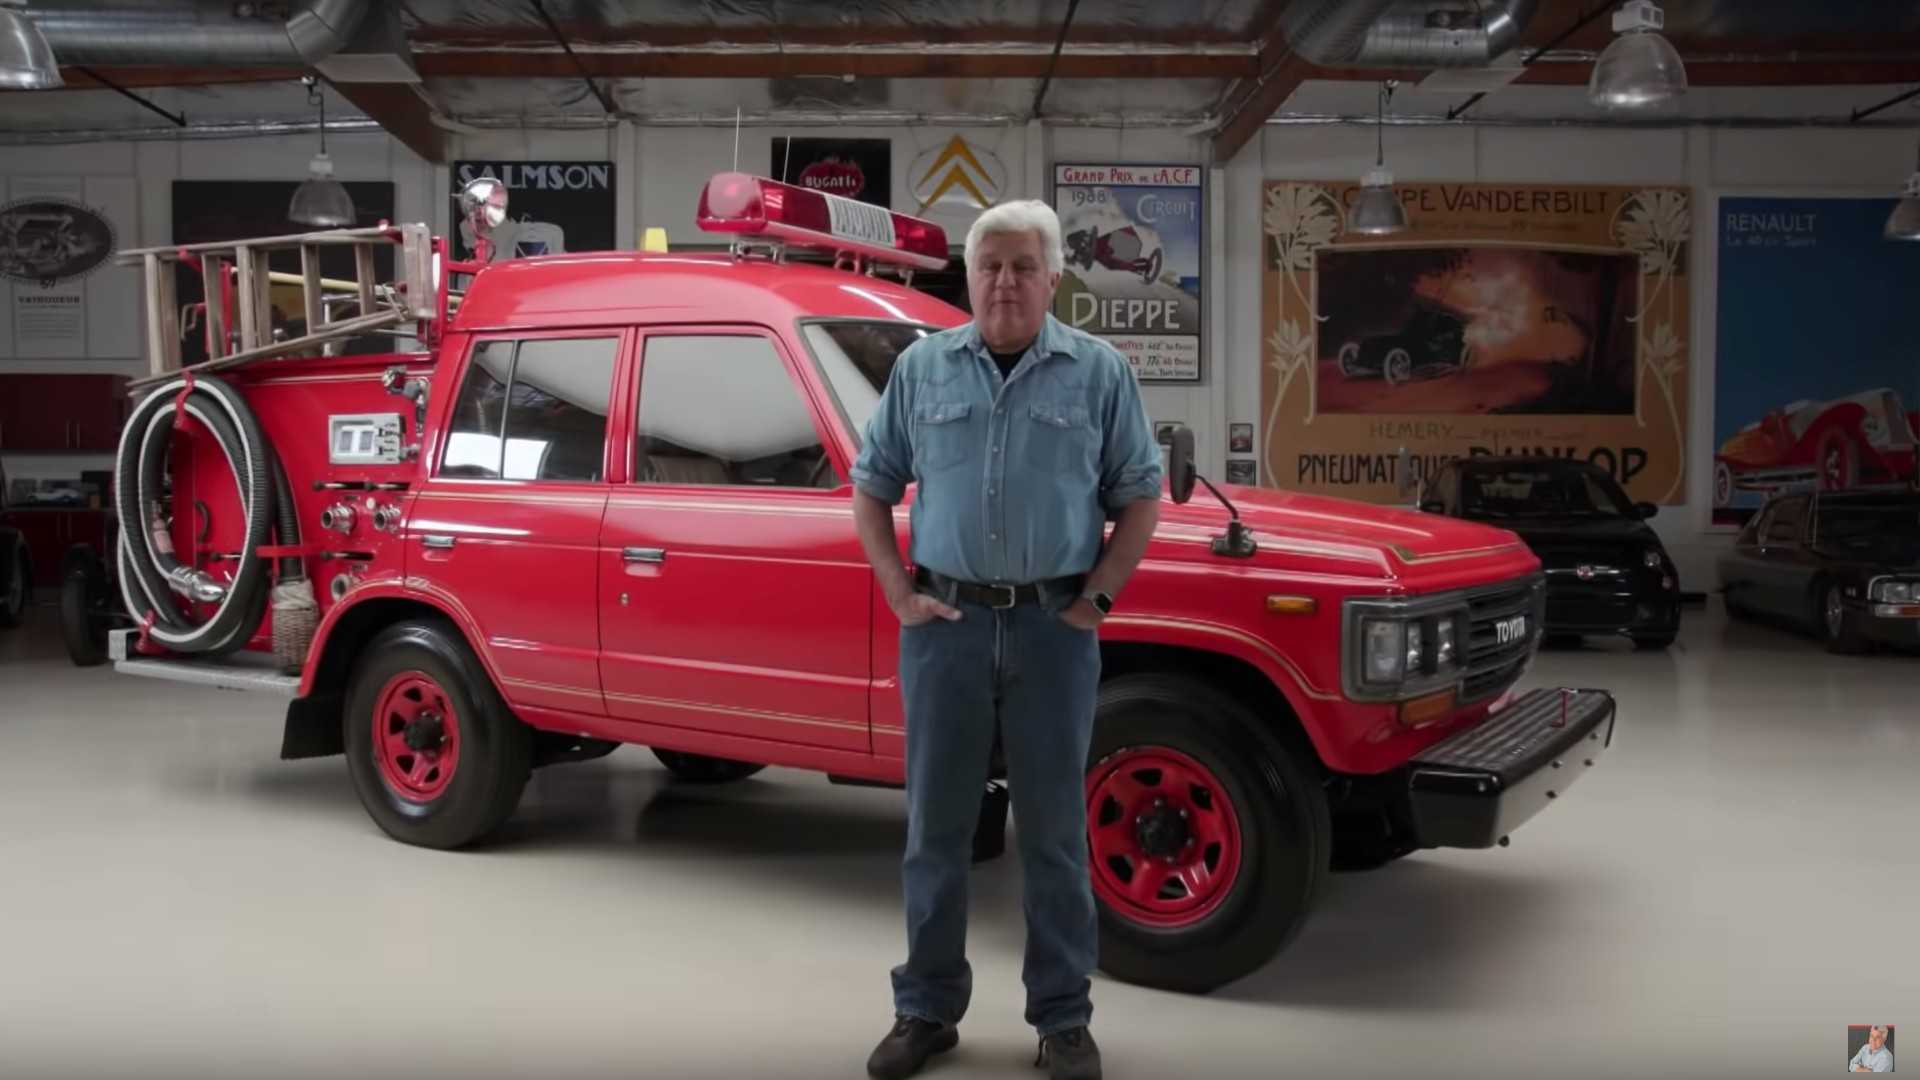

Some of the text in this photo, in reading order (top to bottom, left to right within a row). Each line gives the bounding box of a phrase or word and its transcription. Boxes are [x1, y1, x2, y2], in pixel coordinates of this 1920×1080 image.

[457, 164, 609, 190] SALMSON
[1063, 167, 1104, 183] GRAND
[1110, 168, 1134, 183] PRIX
[1137, 194, 1197, 223] CIRCUIT
[1440, 184, 1608, 214] VANDERBILT
[1727, 213, 1817, 233] RENAULT
[1072, 292, 1180, 329] DIEPPE
[1369, 421, 1454, 440] HEMERY
